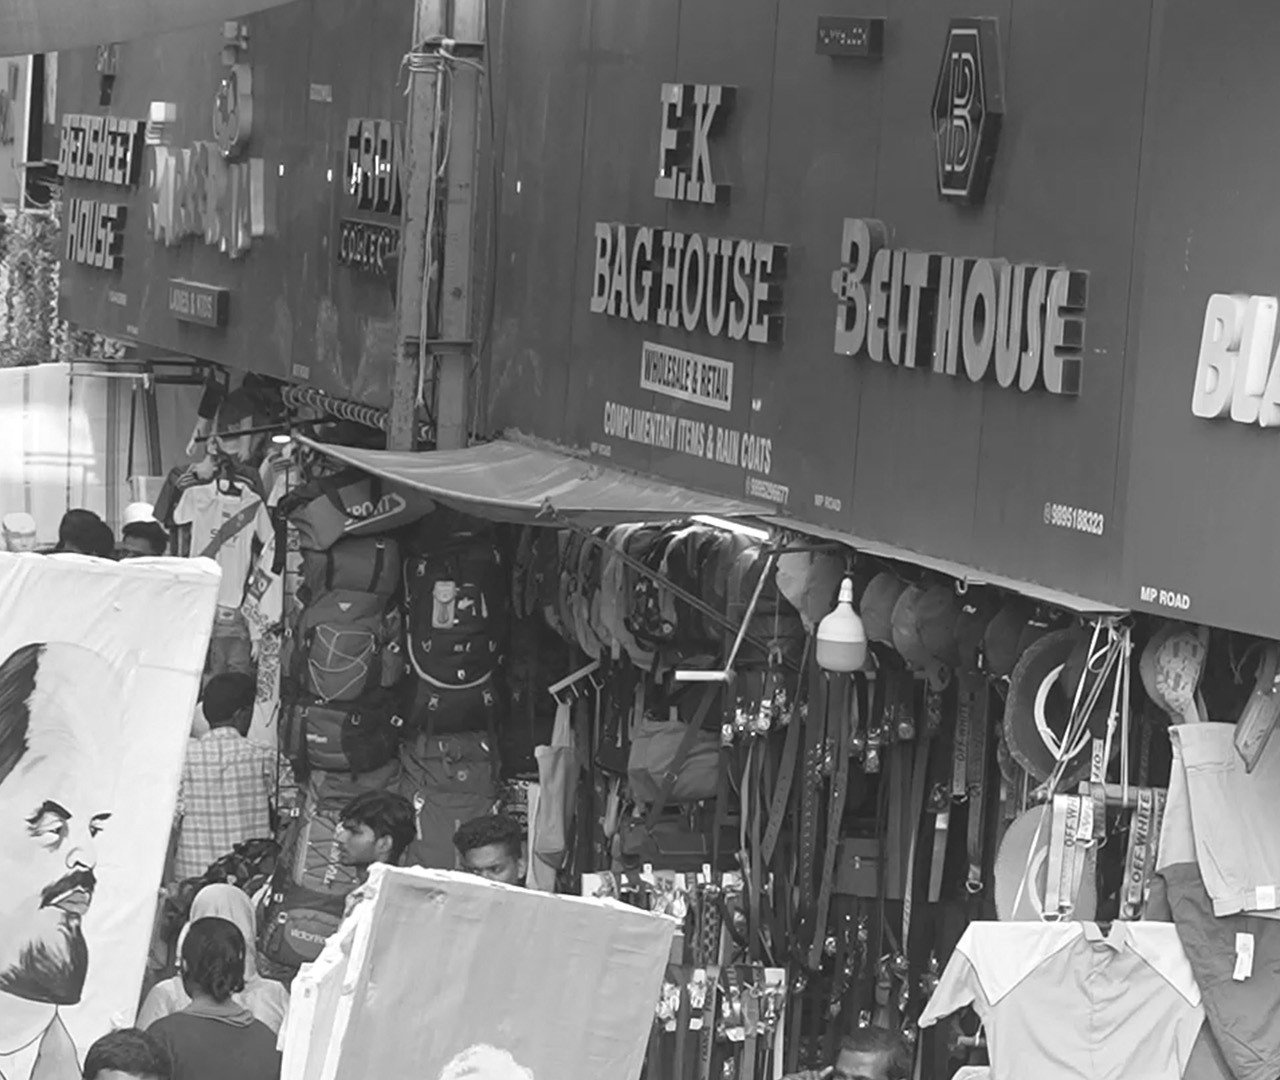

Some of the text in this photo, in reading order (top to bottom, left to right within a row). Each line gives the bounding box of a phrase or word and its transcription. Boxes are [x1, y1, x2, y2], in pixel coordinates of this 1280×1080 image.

[66, 198, 118, 270] HOUSE
[590, 222, 774, 343] BAG HOUSE
[933, 254, 1070, 394] HOUSE
[644, 349, 690, 392] WHOLESALE
[700, 363, 730, 402] RETAIL
[677, 417, 706, 458] ITEMS
[716, 426, 740, 467] RAIN
[741, 432, 772, 475] COATS
[1140, 585, 1190, 610] MP ROAD
